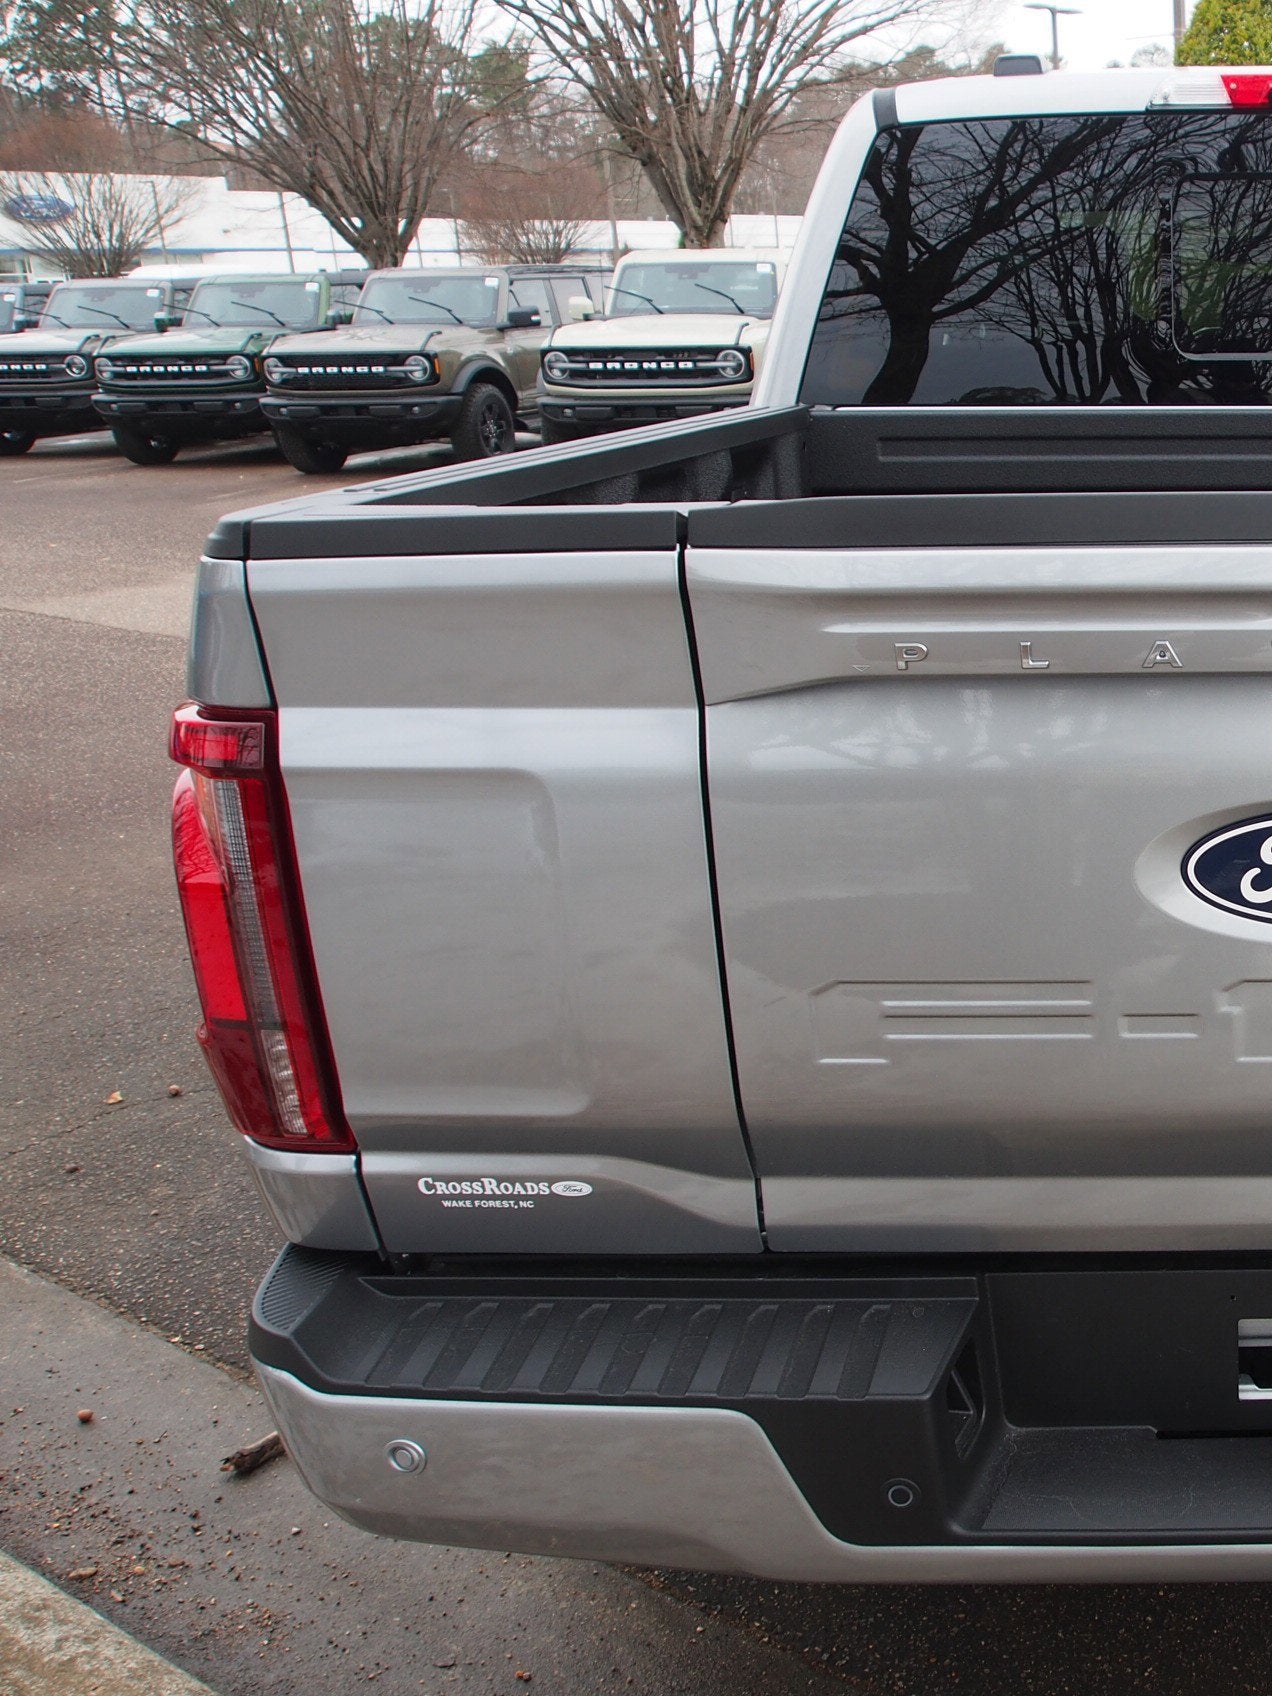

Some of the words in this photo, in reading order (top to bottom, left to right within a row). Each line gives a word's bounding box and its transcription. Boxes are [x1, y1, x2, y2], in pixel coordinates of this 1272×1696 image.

[297, 365, 385, 373] BRONCO
[588, 361, 693, 370] BRONCO
[441, 1200, 473, 1208] WAKE
[474, 1200, 518, 1209] FOREST,
[519, 1200, 534, 1208] NC
